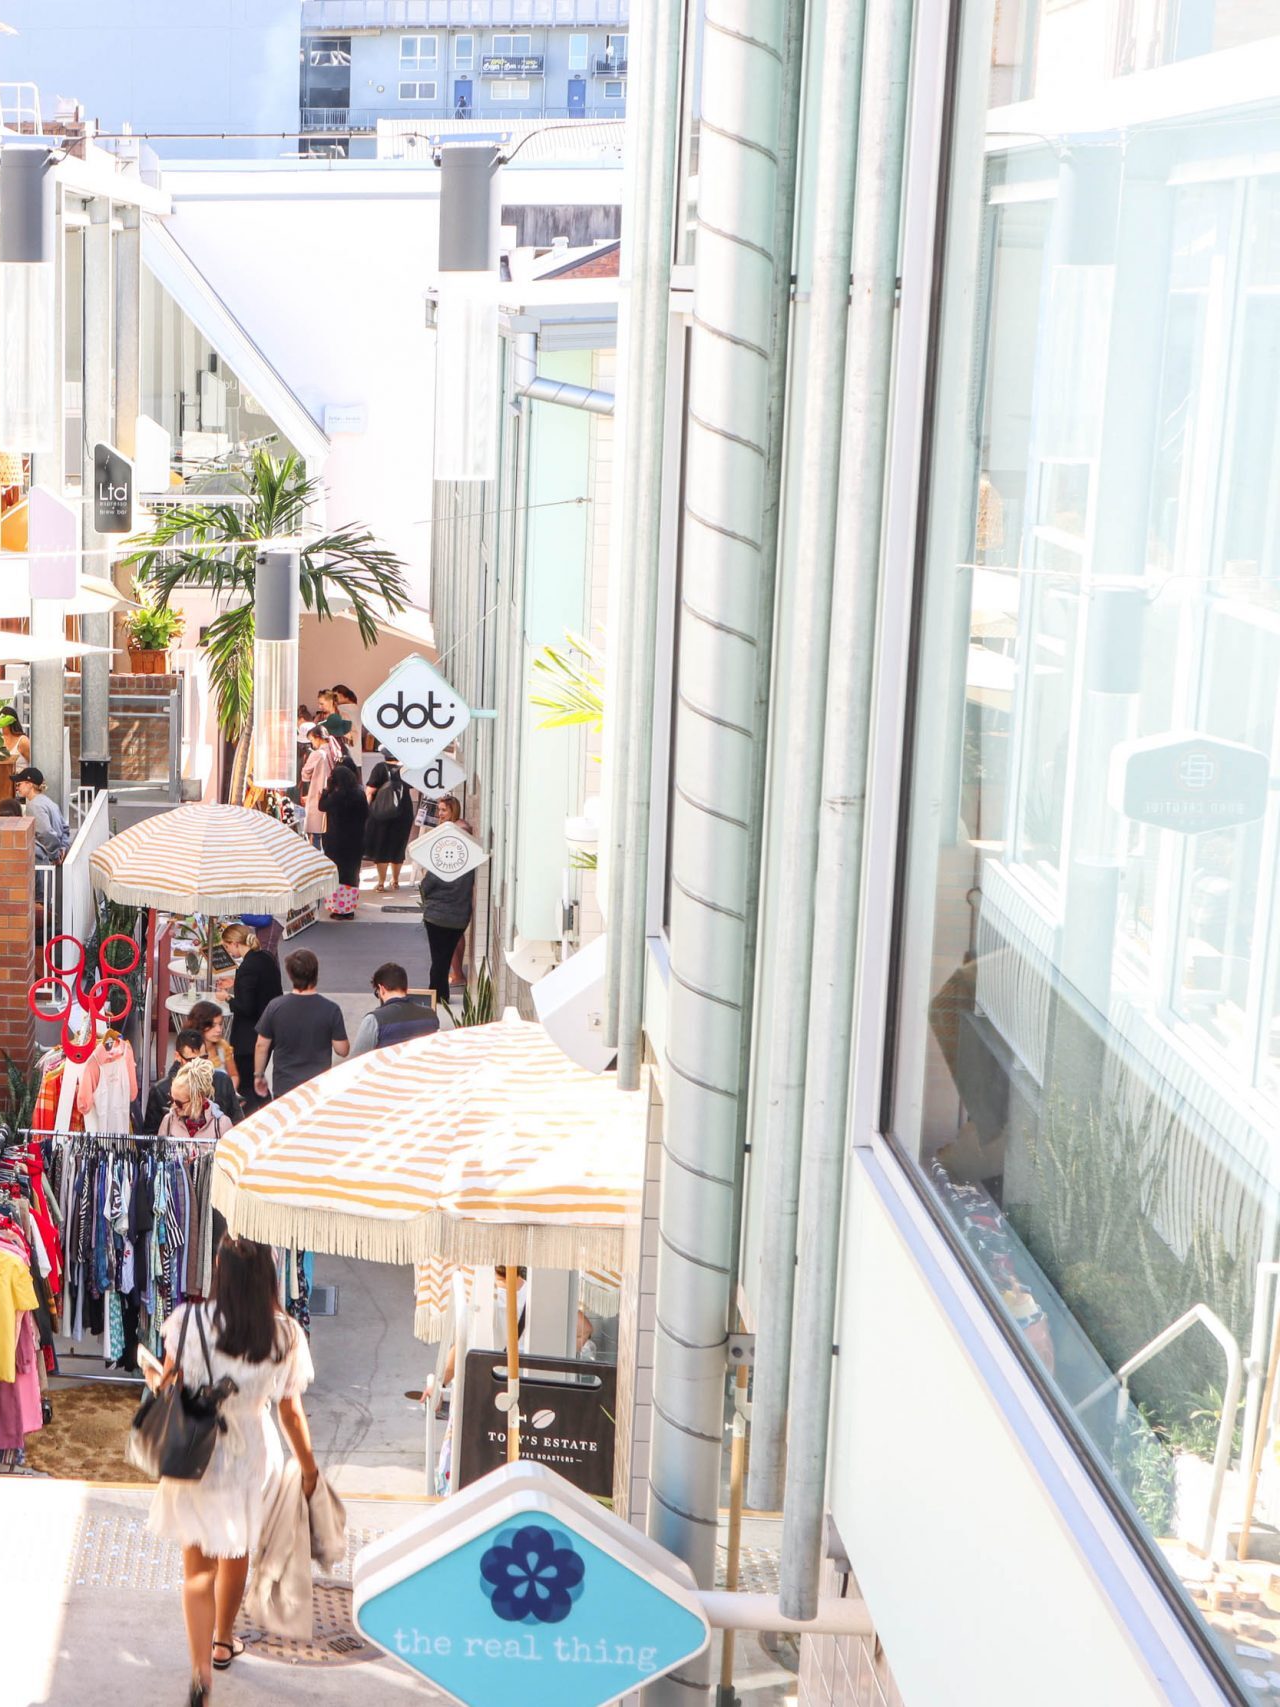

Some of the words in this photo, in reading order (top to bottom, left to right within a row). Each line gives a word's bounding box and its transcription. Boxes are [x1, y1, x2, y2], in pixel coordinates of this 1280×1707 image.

[99, 482, 128, 501] Ltd
[411, 736, 434, 744] Design
[423, 759, 445, 789] d
[434, 844, 465, 871] nightingale
[487, 1431, 538, 1446] TOY'S
[543, 1437, 598, 1452] ESTATE
[537, 1453, 574, 1463] ROASTERS
[393, 1627, 452, 1656] the
[463, 1634, 542, 1660] real
[555, 1636, 658, 1671] thing
